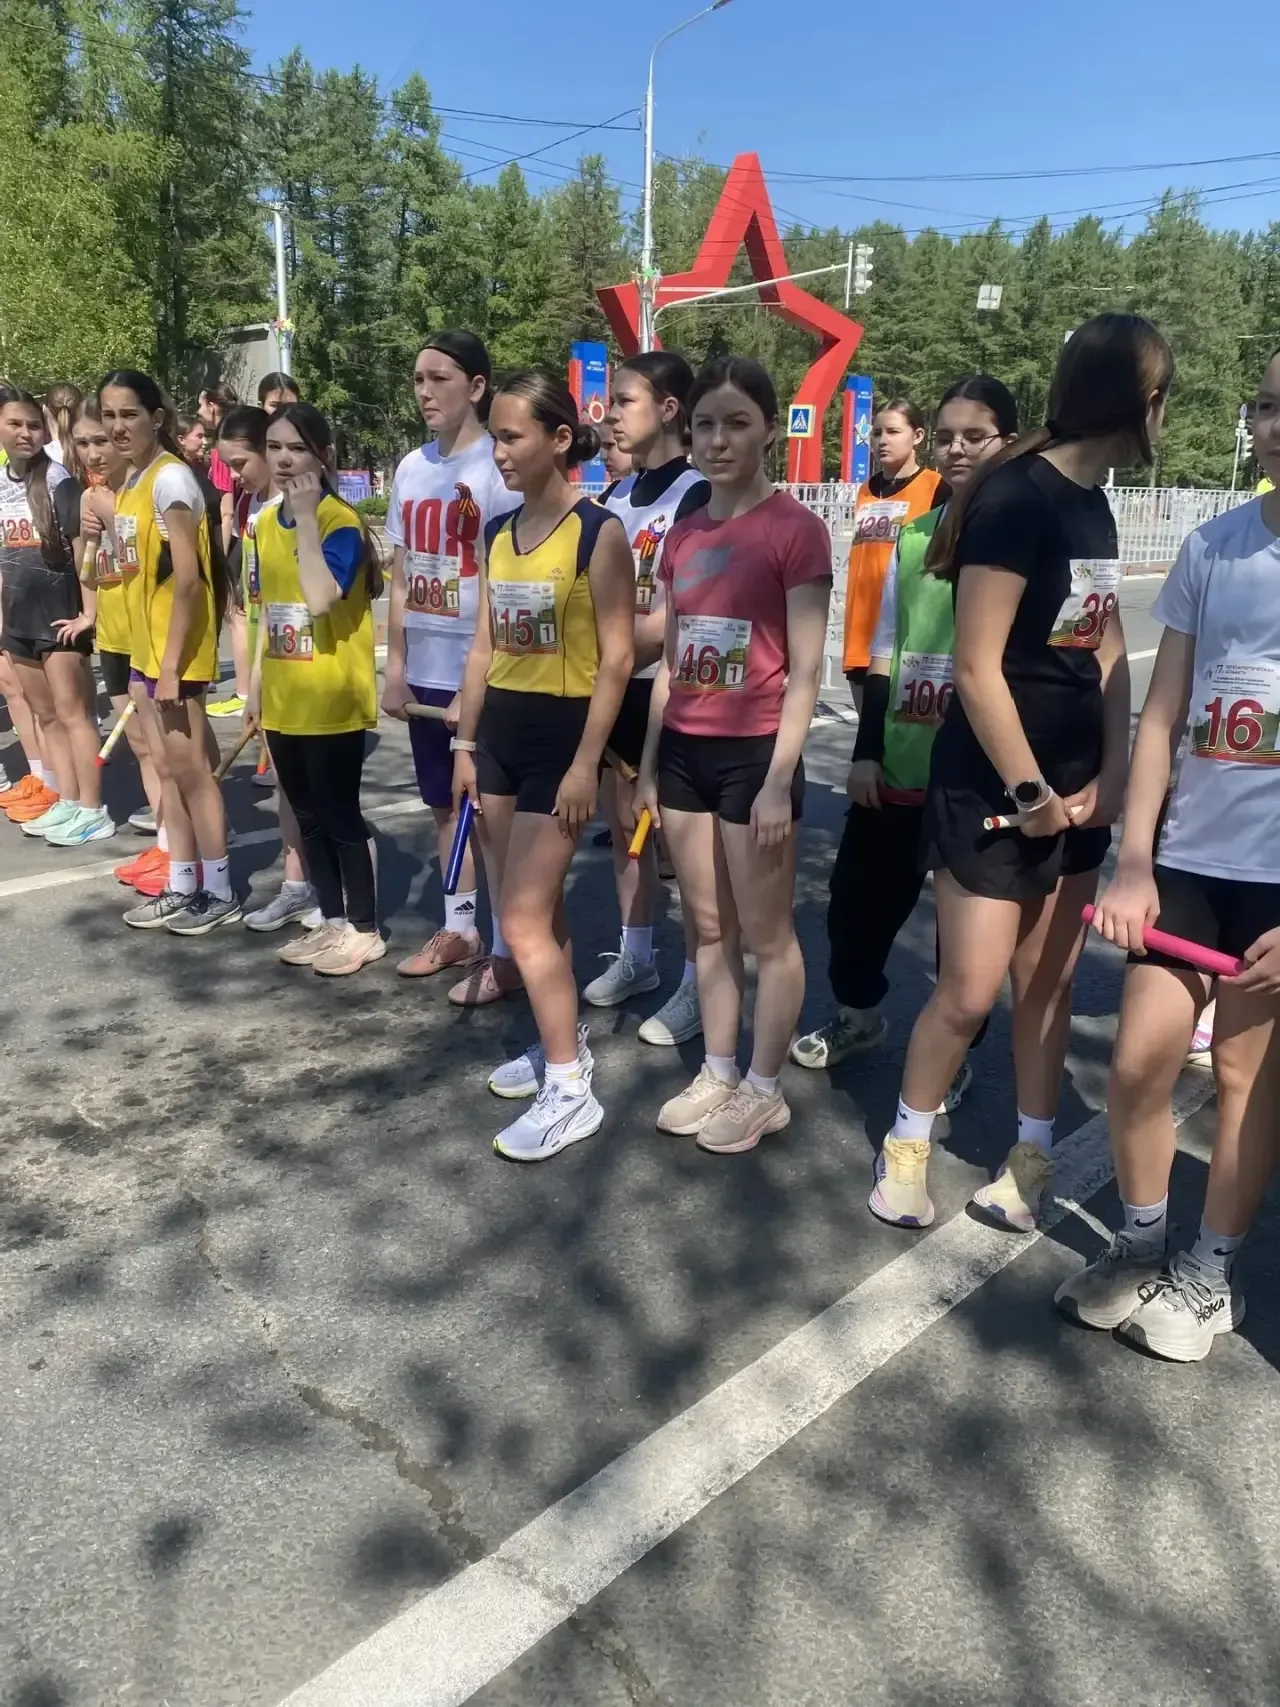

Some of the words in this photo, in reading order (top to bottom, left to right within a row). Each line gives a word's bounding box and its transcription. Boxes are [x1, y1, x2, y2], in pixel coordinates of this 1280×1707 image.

[857, 515, 890, 538] 129
[402, 498, 481, 577] 108
[449, 592, 455, 606] 1
[639, 587, 646, 603] 1
[543, 625, 551, 641] 1
[304, 637, 309, 651] 1
[680, 643, 720, 685] 46
[729, 665, 738, 682] 1
[1204, 696, 1264, 752] 16
[1182, 1259, 1201, 1272] HOKA
